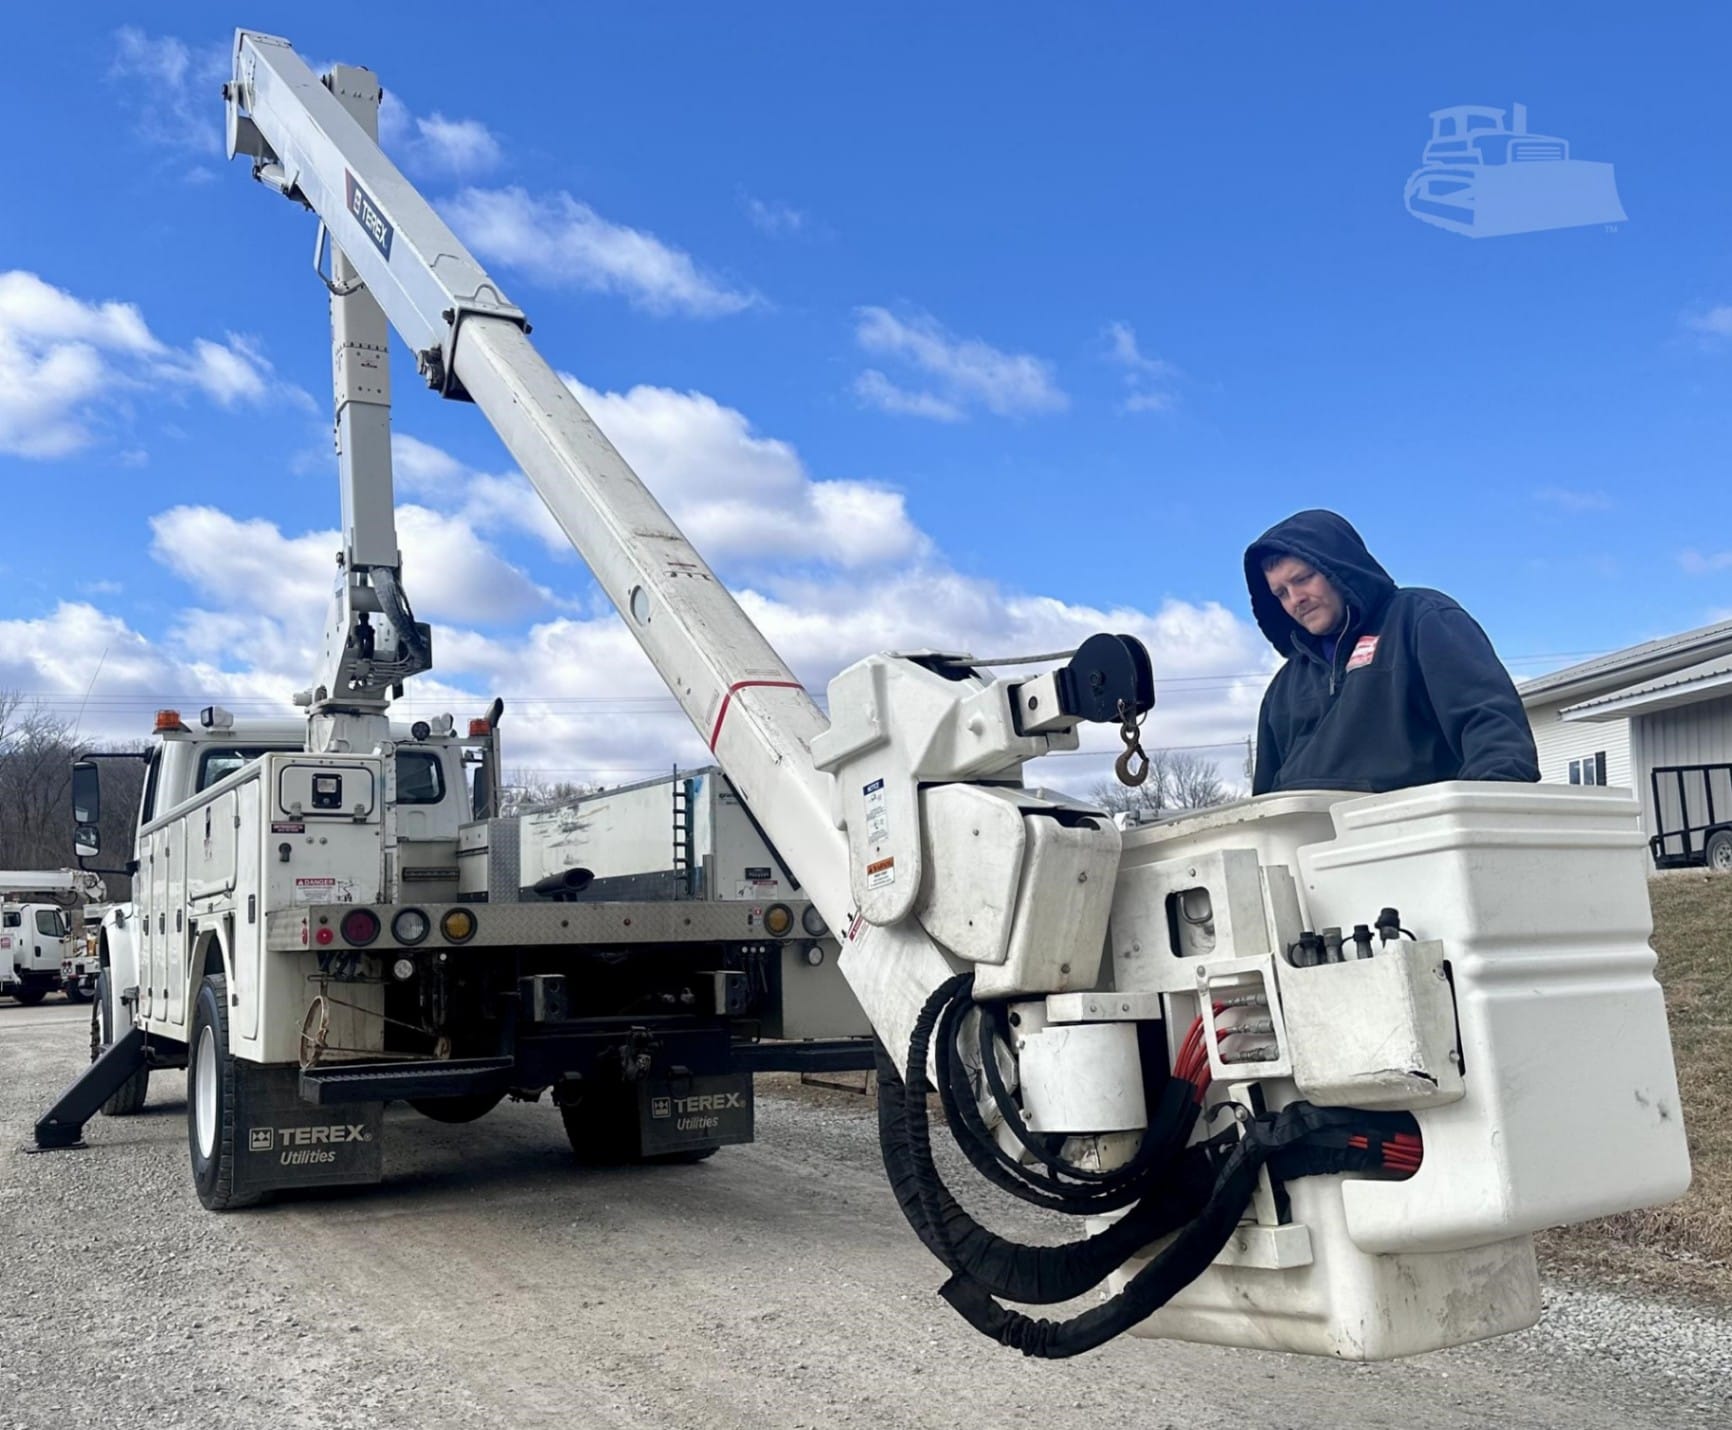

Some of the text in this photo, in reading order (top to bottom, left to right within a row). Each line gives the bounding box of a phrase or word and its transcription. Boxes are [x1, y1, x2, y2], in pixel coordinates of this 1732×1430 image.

[361, 199, 388, 248] TEREX
[673, 1092, 740, 1113] TEREX
[676, 1115, 719, 1131] Utilities
[278, 1124, 365, 1146] TEREX
[280, 1149, 336, 1166] Utilities
